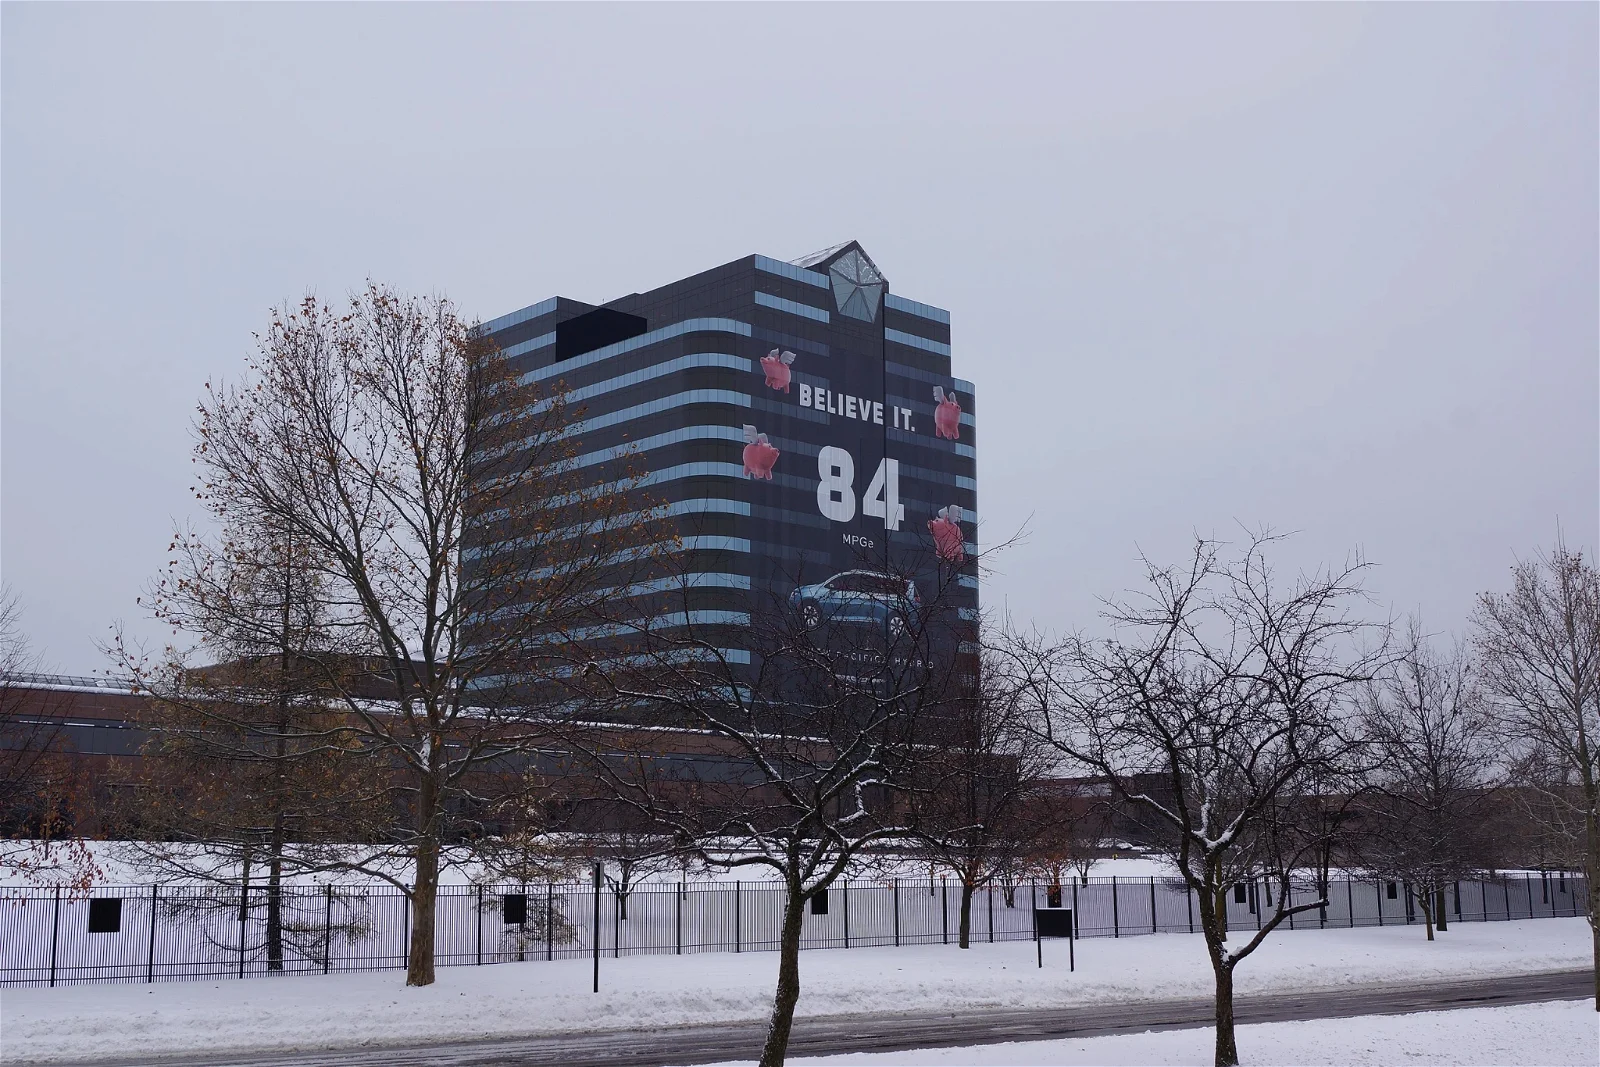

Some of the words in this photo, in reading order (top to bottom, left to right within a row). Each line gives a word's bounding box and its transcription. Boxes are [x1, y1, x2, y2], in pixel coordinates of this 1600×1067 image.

[799, 383, 884, 426] BELIEVE
[893, 405, 917, 432] IT.
[816, 445, 905, 532] 84
[842, 533, 874, 549] MPGe
[894, 657, 934, 669] HYRD
